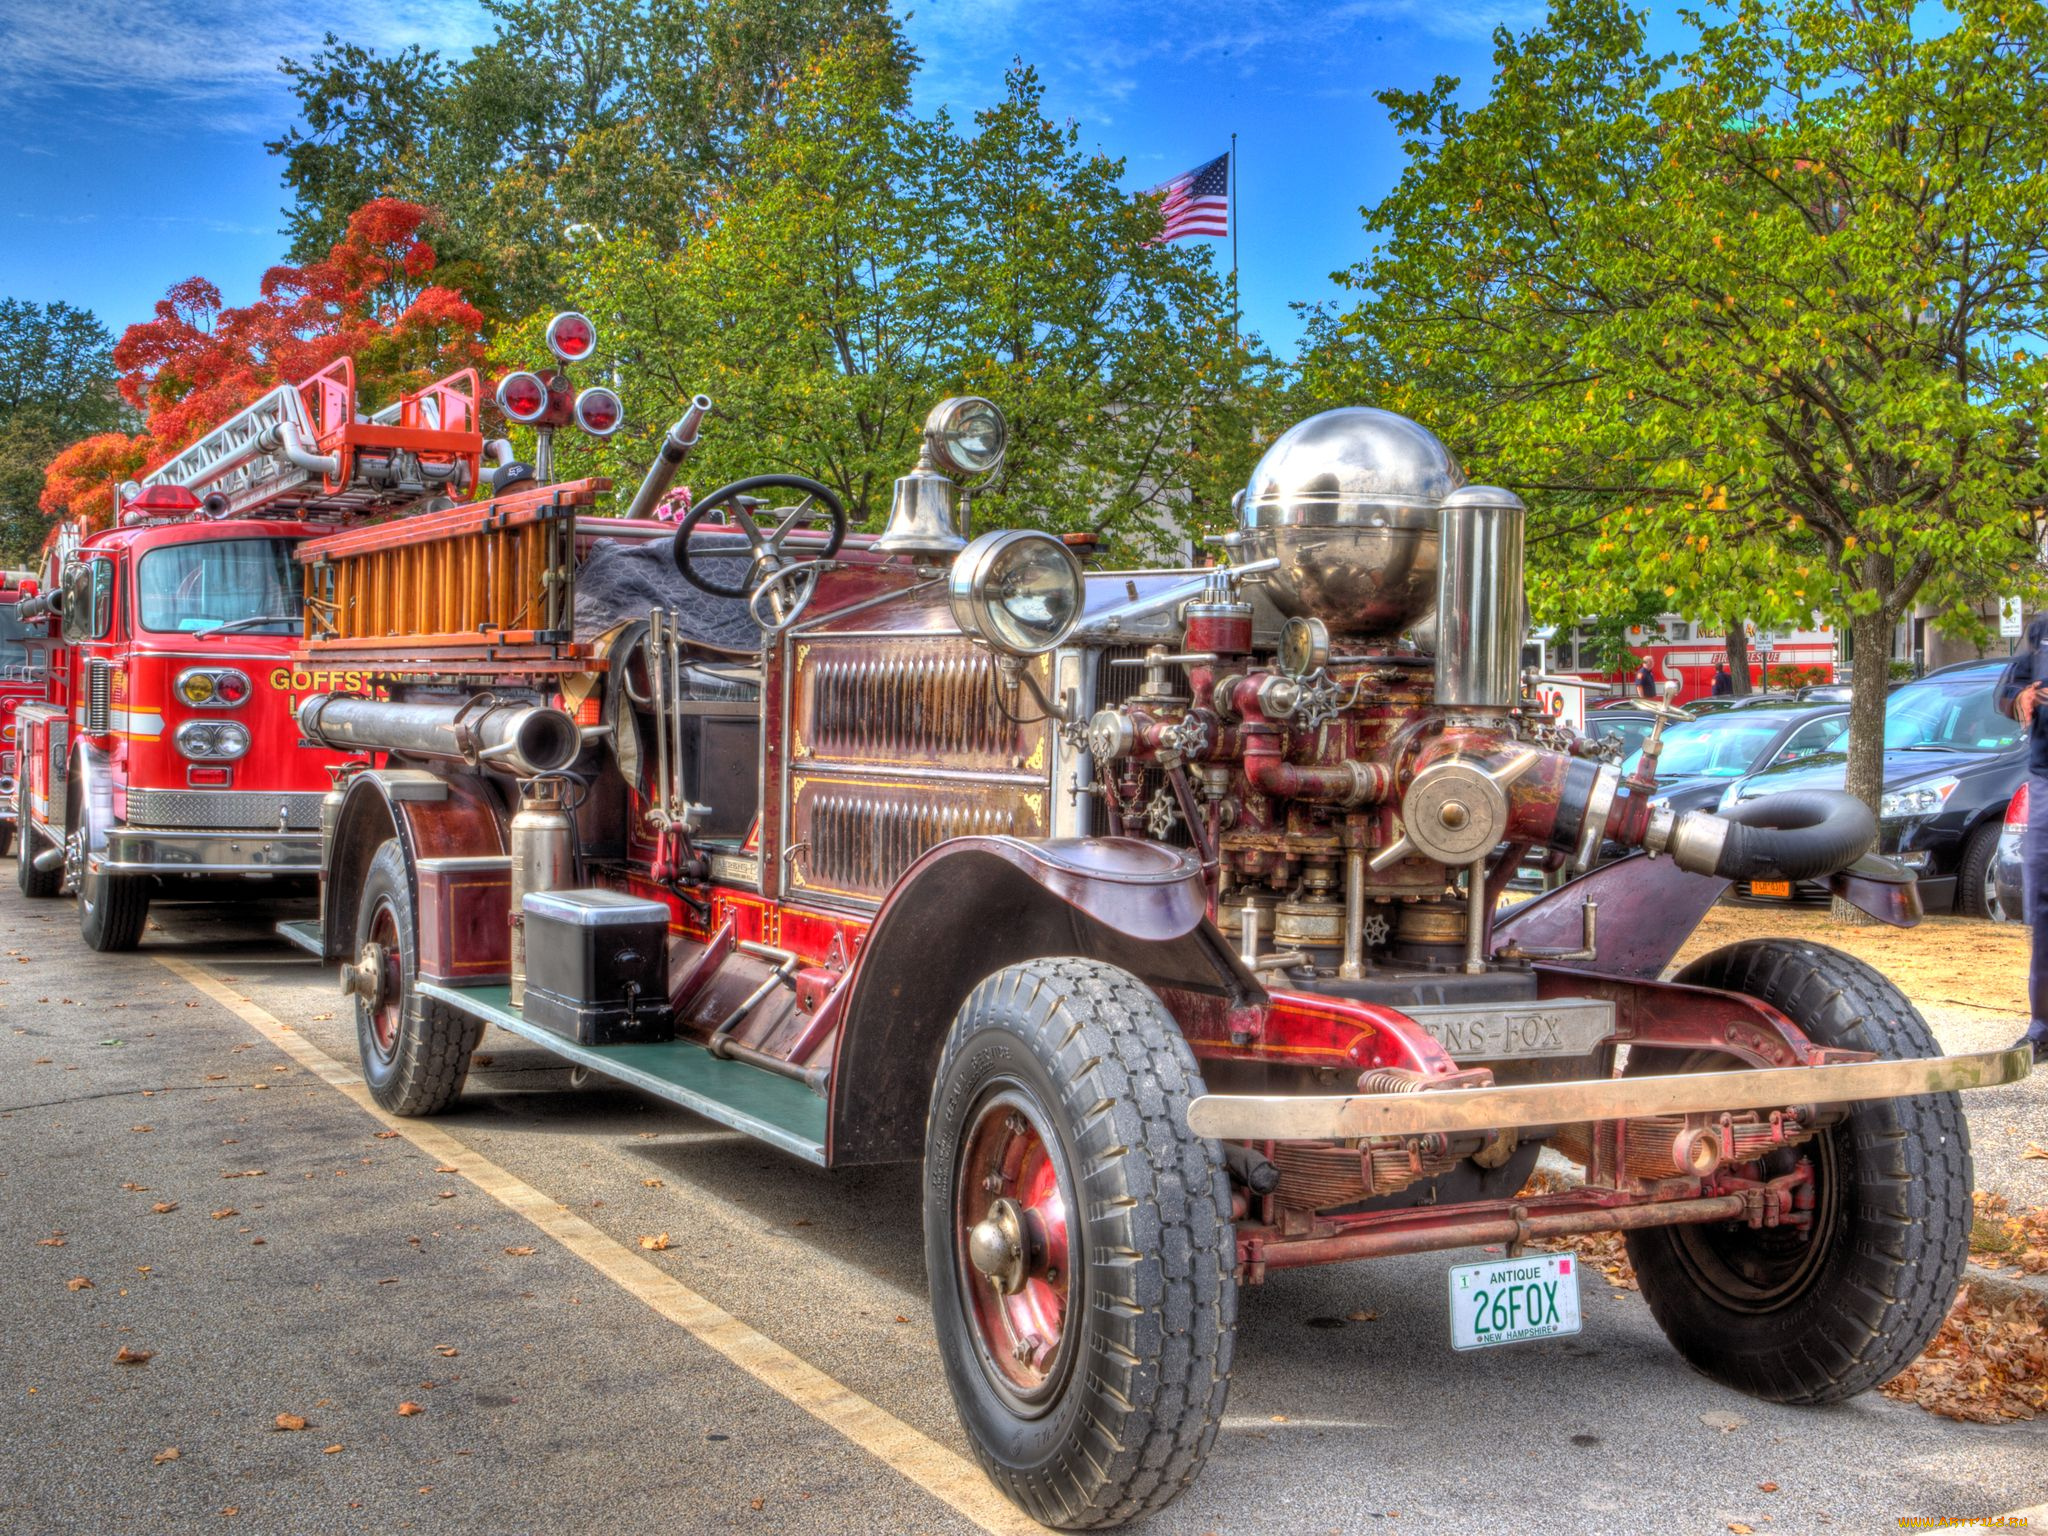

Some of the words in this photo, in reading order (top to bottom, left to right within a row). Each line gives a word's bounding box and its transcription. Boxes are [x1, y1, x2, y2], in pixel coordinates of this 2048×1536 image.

[1490, 1266, 1541, 1285] ANTIQUE
[1473, 1280, 1560, 1334] 26FOX
[1483, 1333, 1502, 1343] NEW
[1506, 1325, 1552, 1340] HAMPSHIRE
